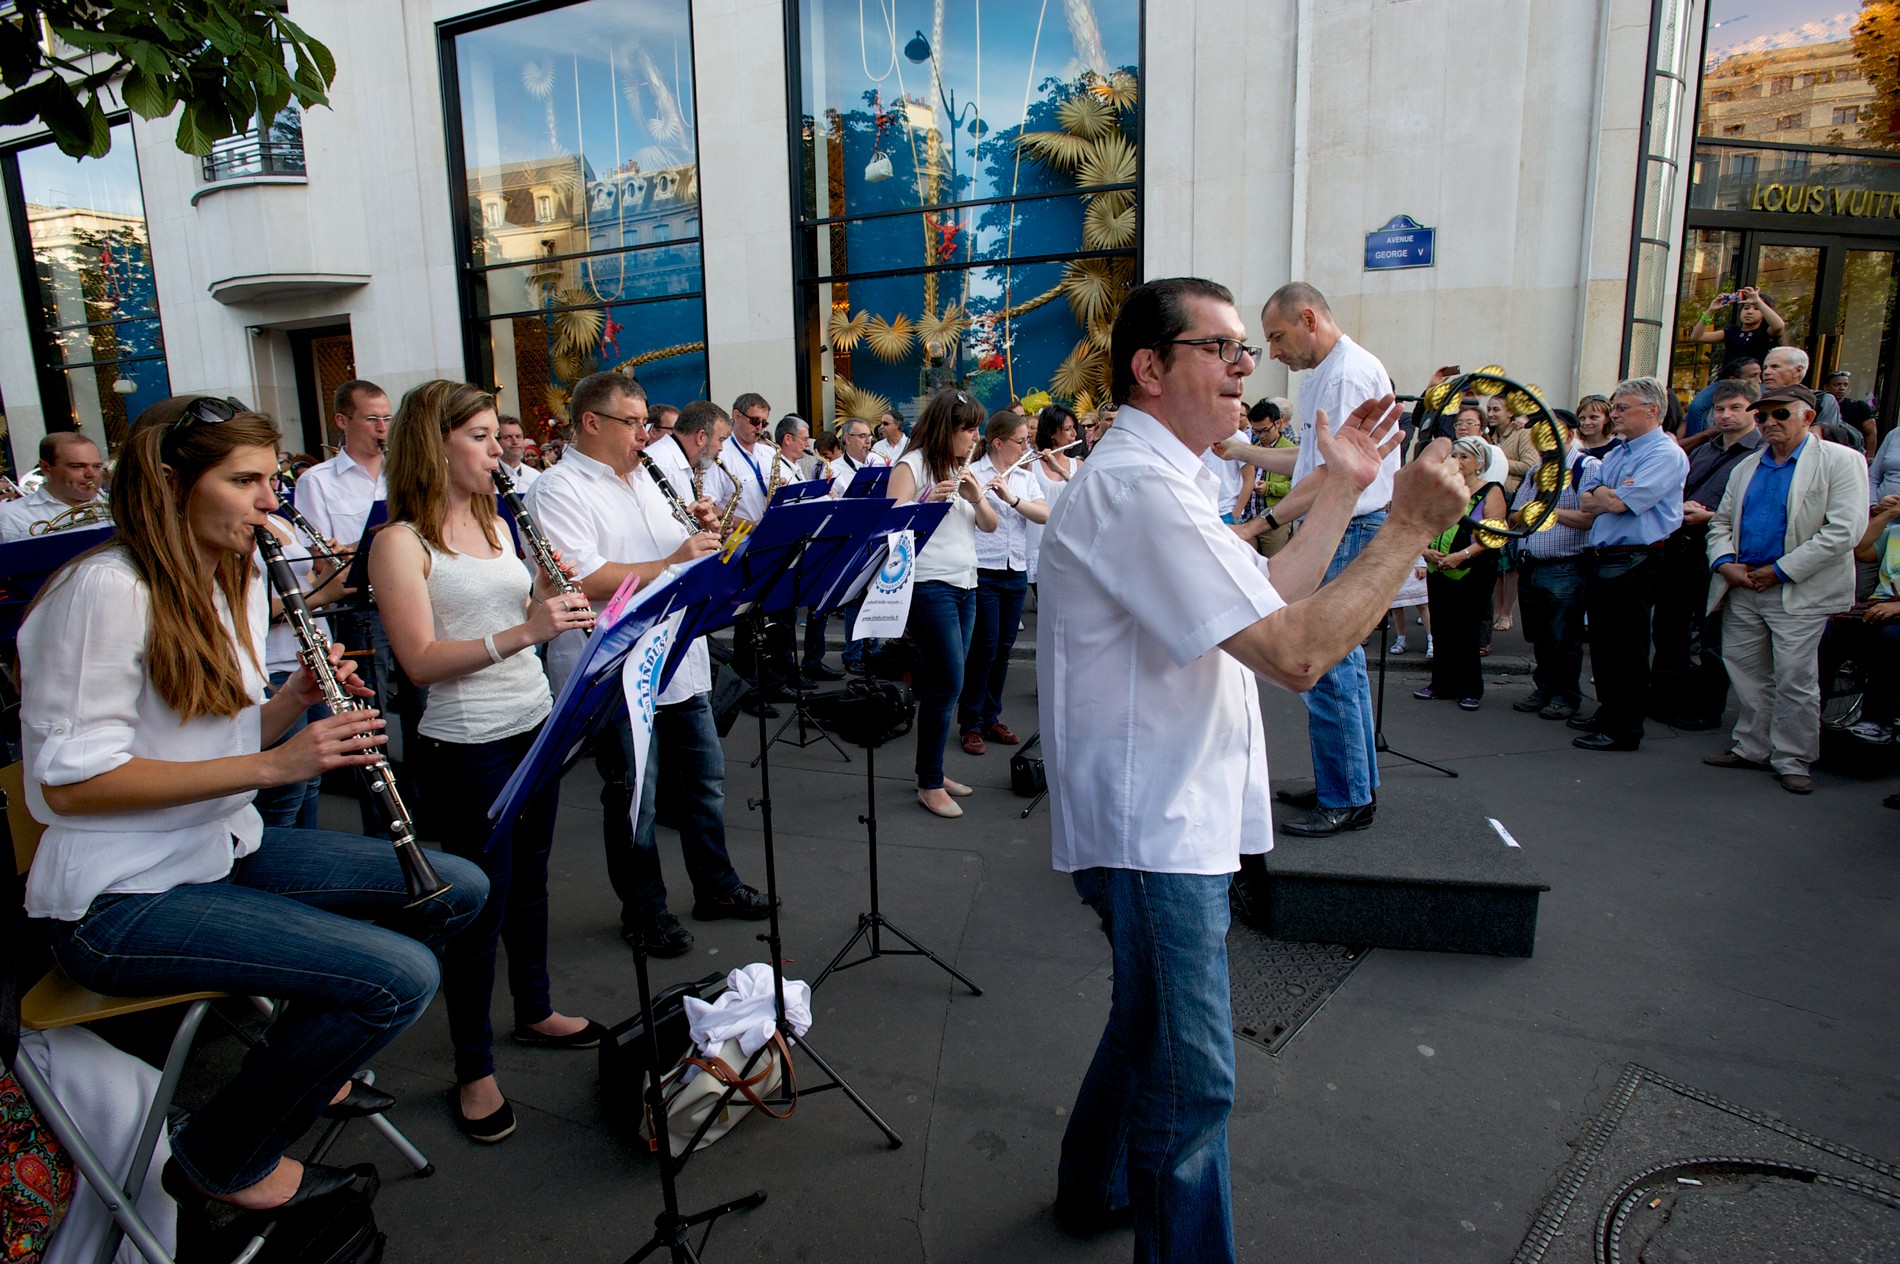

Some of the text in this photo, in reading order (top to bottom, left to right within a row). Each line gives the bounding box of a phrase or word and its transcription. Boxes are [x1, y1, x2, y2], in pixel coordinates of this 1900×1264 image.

[1751, 183, 1900, 218] LOUIS VUITT
[1386, 235, 1414, 244] AVENUE
[1375, 248, 1424, 259] GEORGE V
[642, 636, 668, 698] L'INDUS
